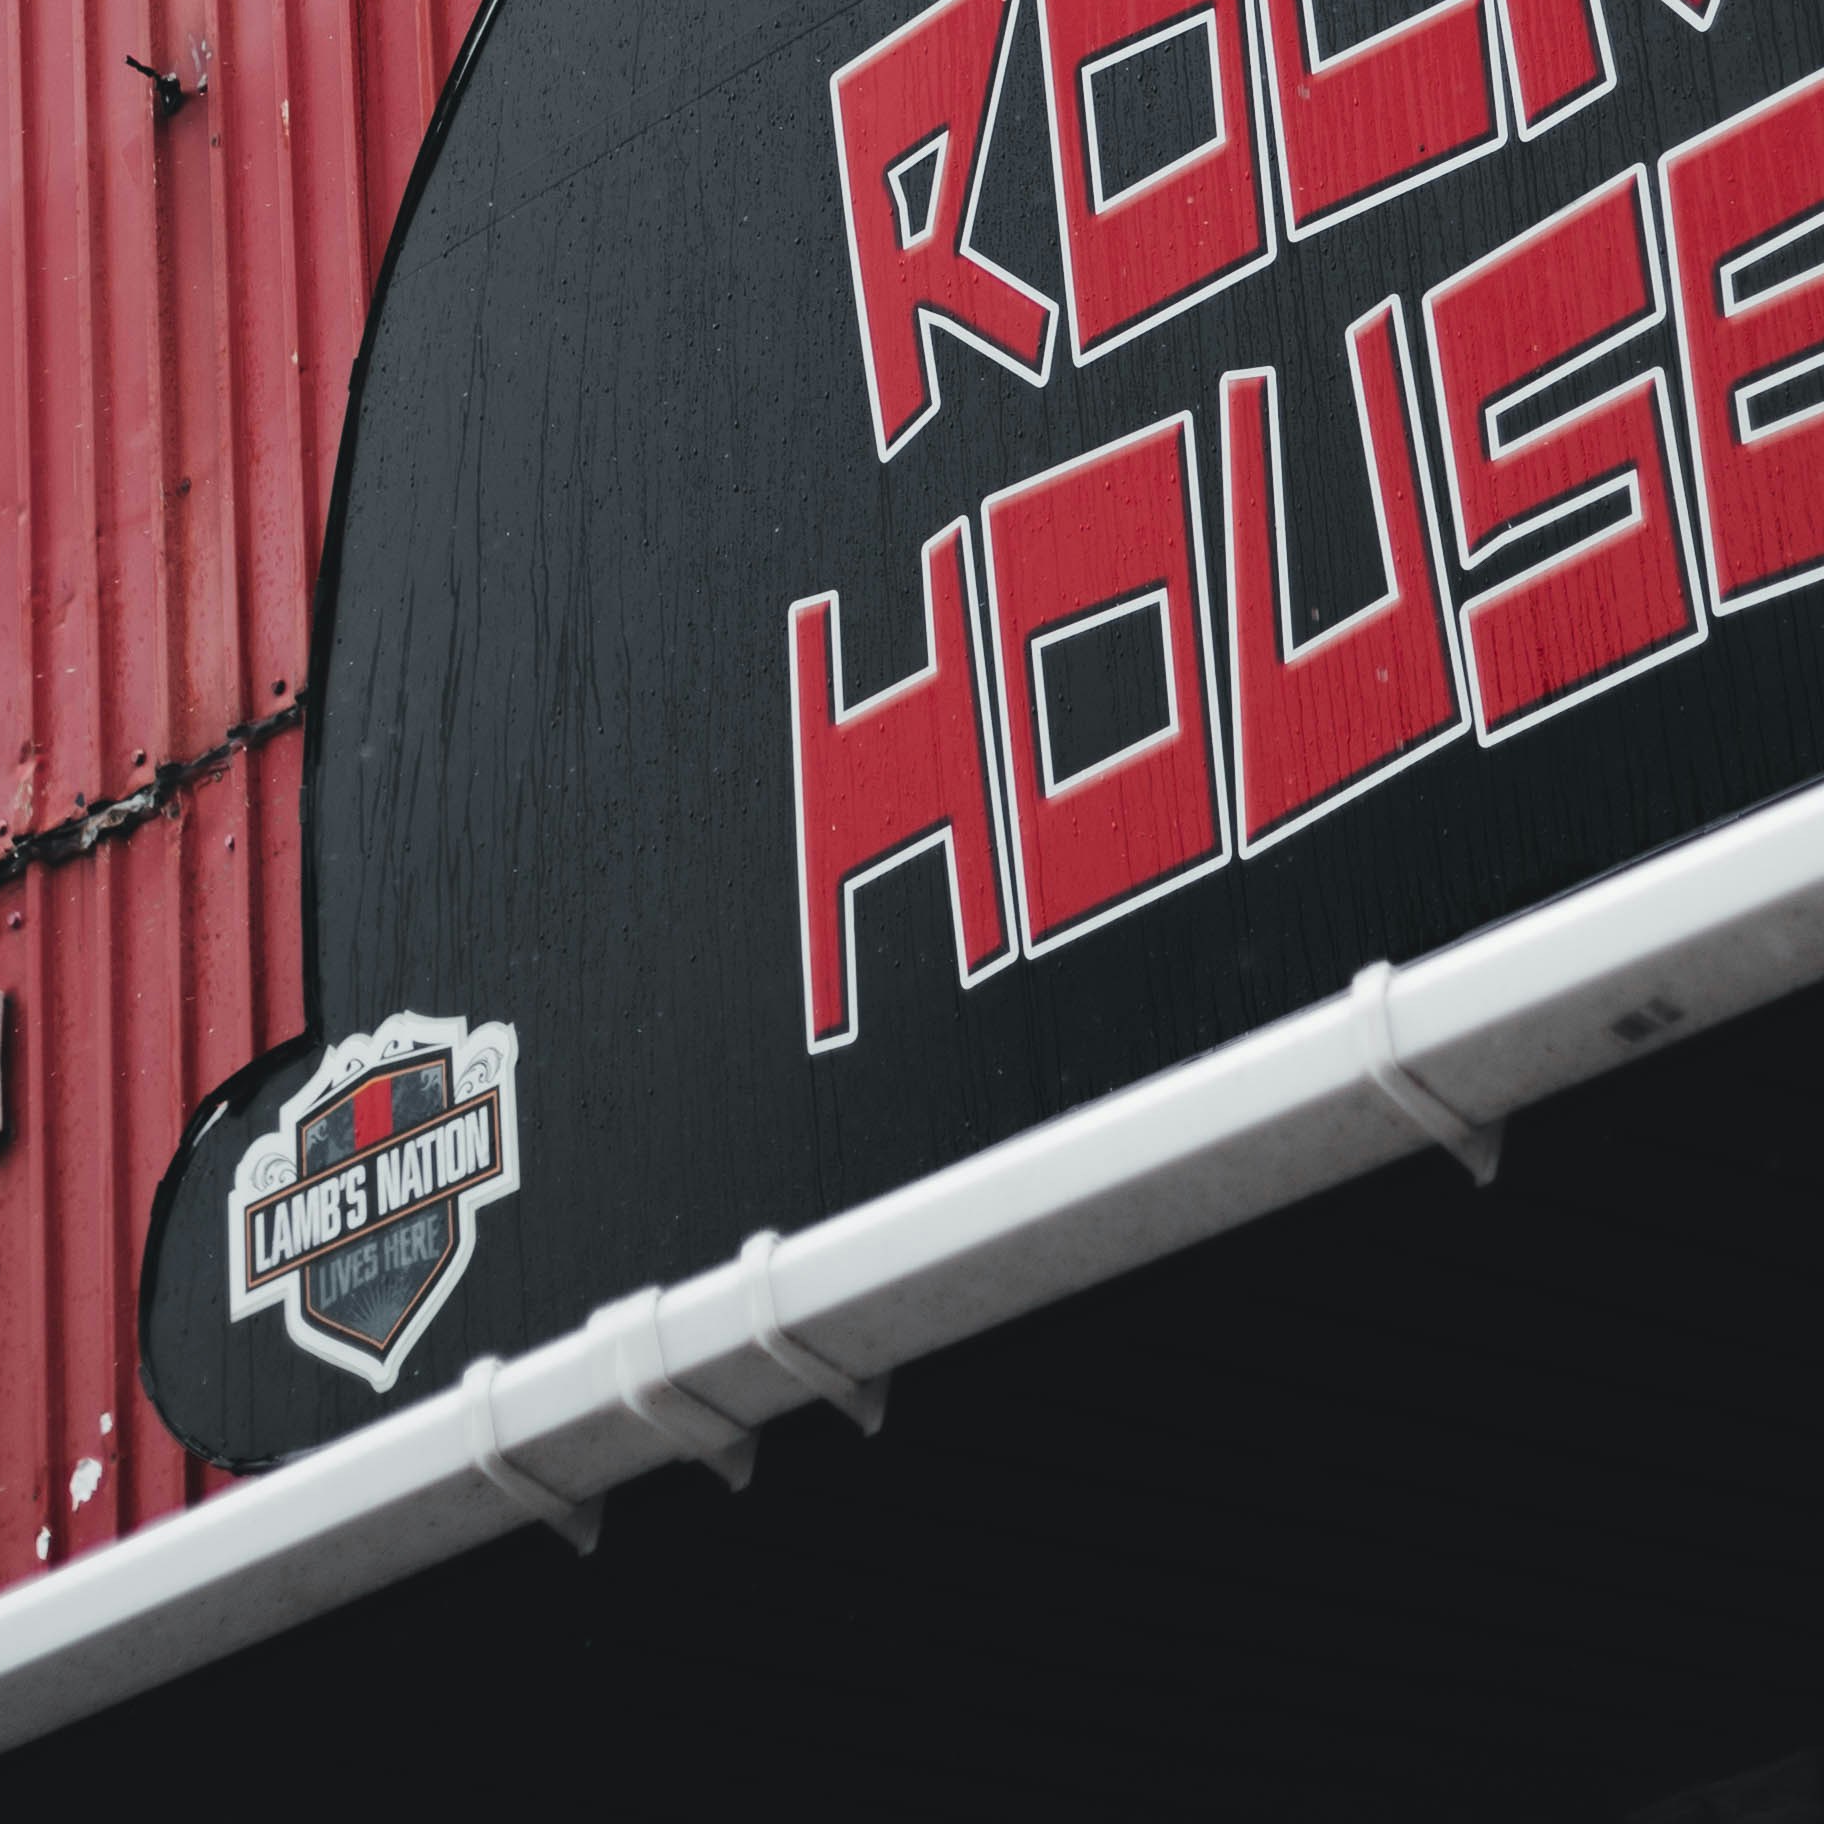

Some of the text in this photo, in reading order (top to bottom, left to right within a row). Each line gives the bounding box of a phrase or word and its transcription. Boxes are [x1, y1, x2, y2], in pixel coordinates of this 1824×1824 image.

[254, 1105, 491, 1274] LAMB'S NATION
[318, 1214, 440, 1310] LIVES HERE
